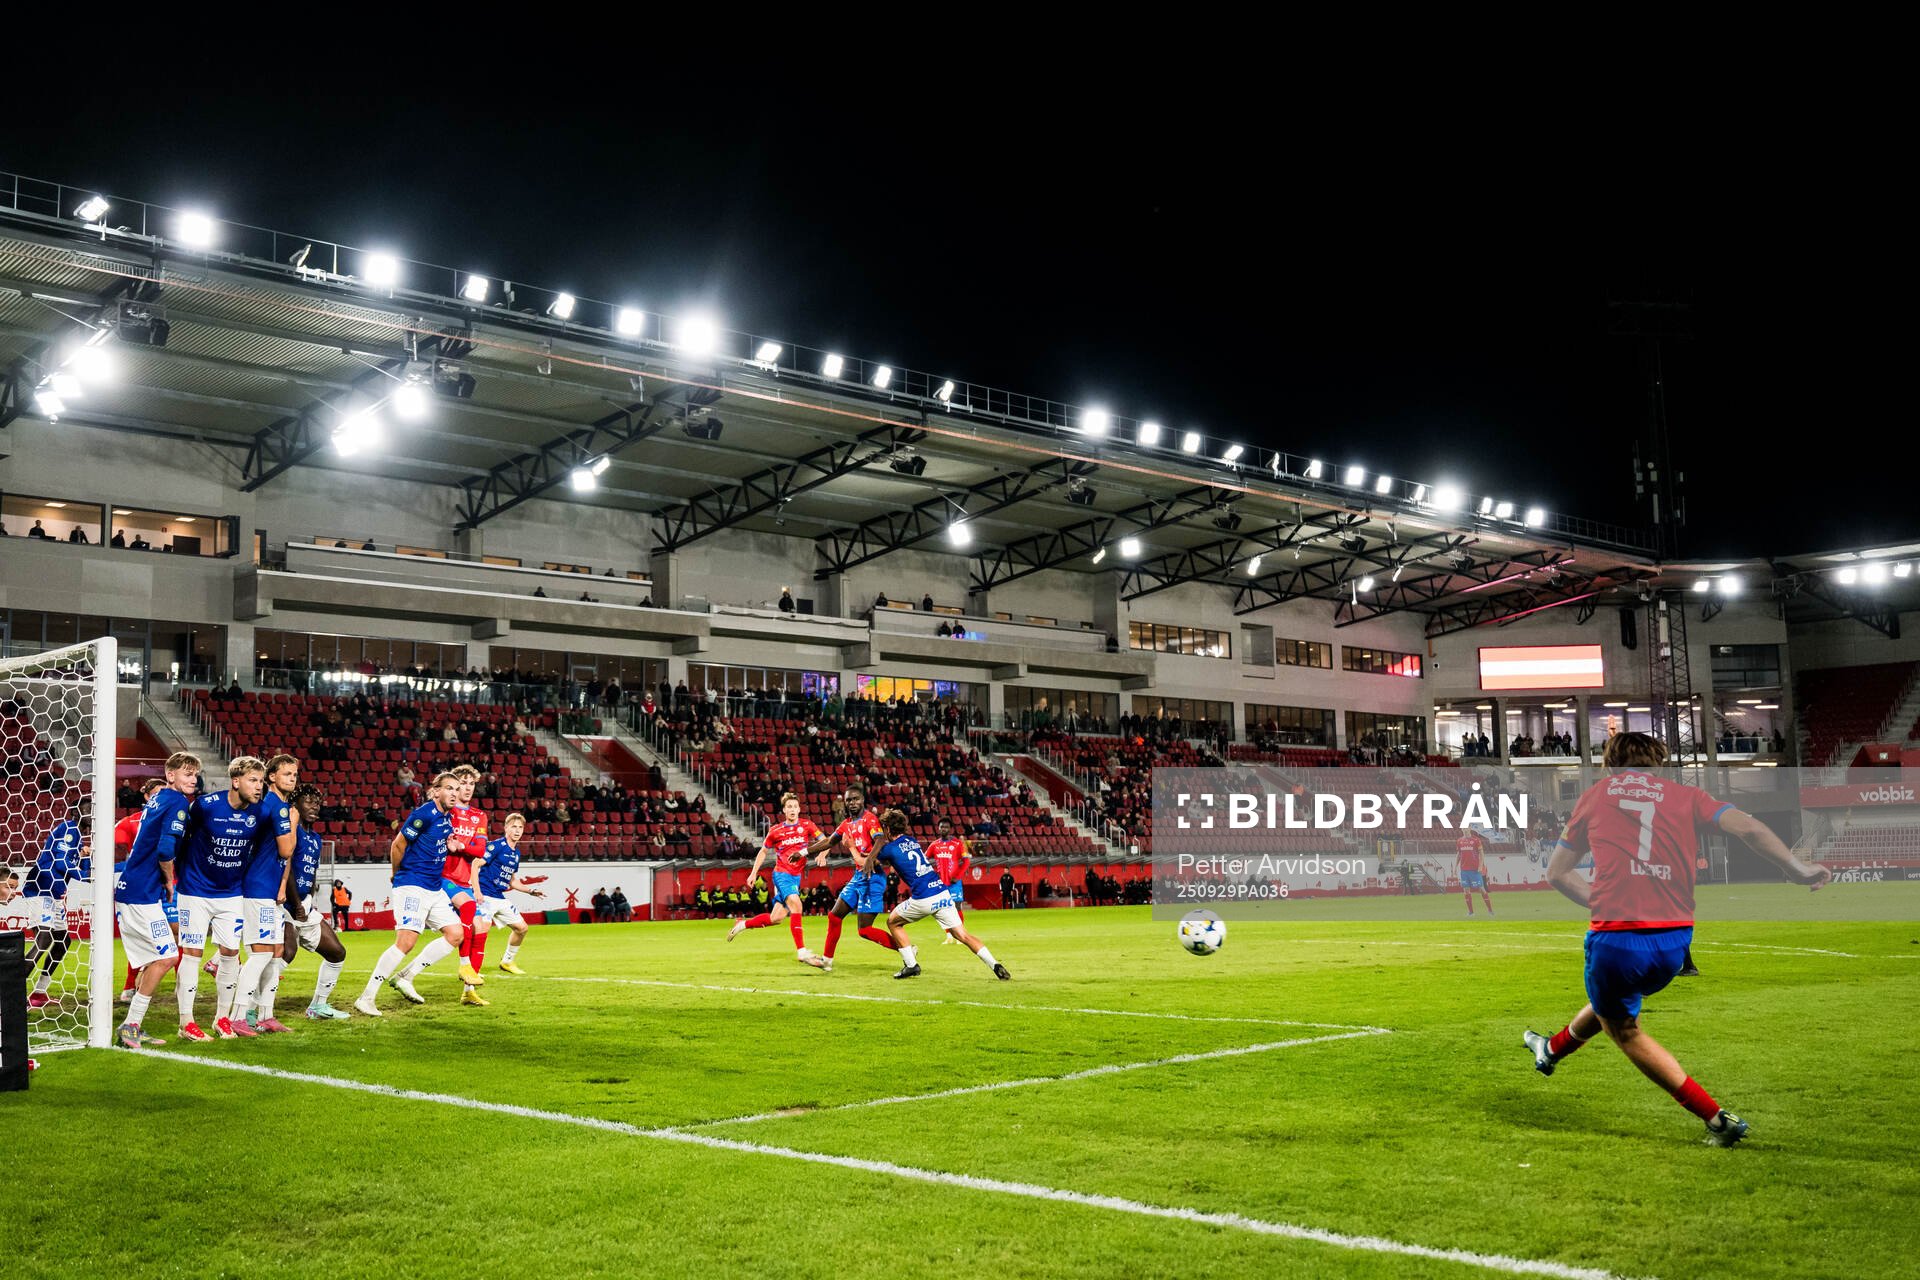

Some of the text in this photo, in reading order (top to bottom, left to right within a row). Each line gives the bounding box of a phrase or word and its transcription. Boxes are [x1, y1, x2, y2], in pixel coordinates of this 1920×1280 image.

[1860, 786, 1914, 803] vobbiz
[453, 825, 476, 837] obbi
[1619, 799, 1655, 861] 7
[211, 836, 249, 847] MELLBY
[213, 847, 241, 857] GÅRD
